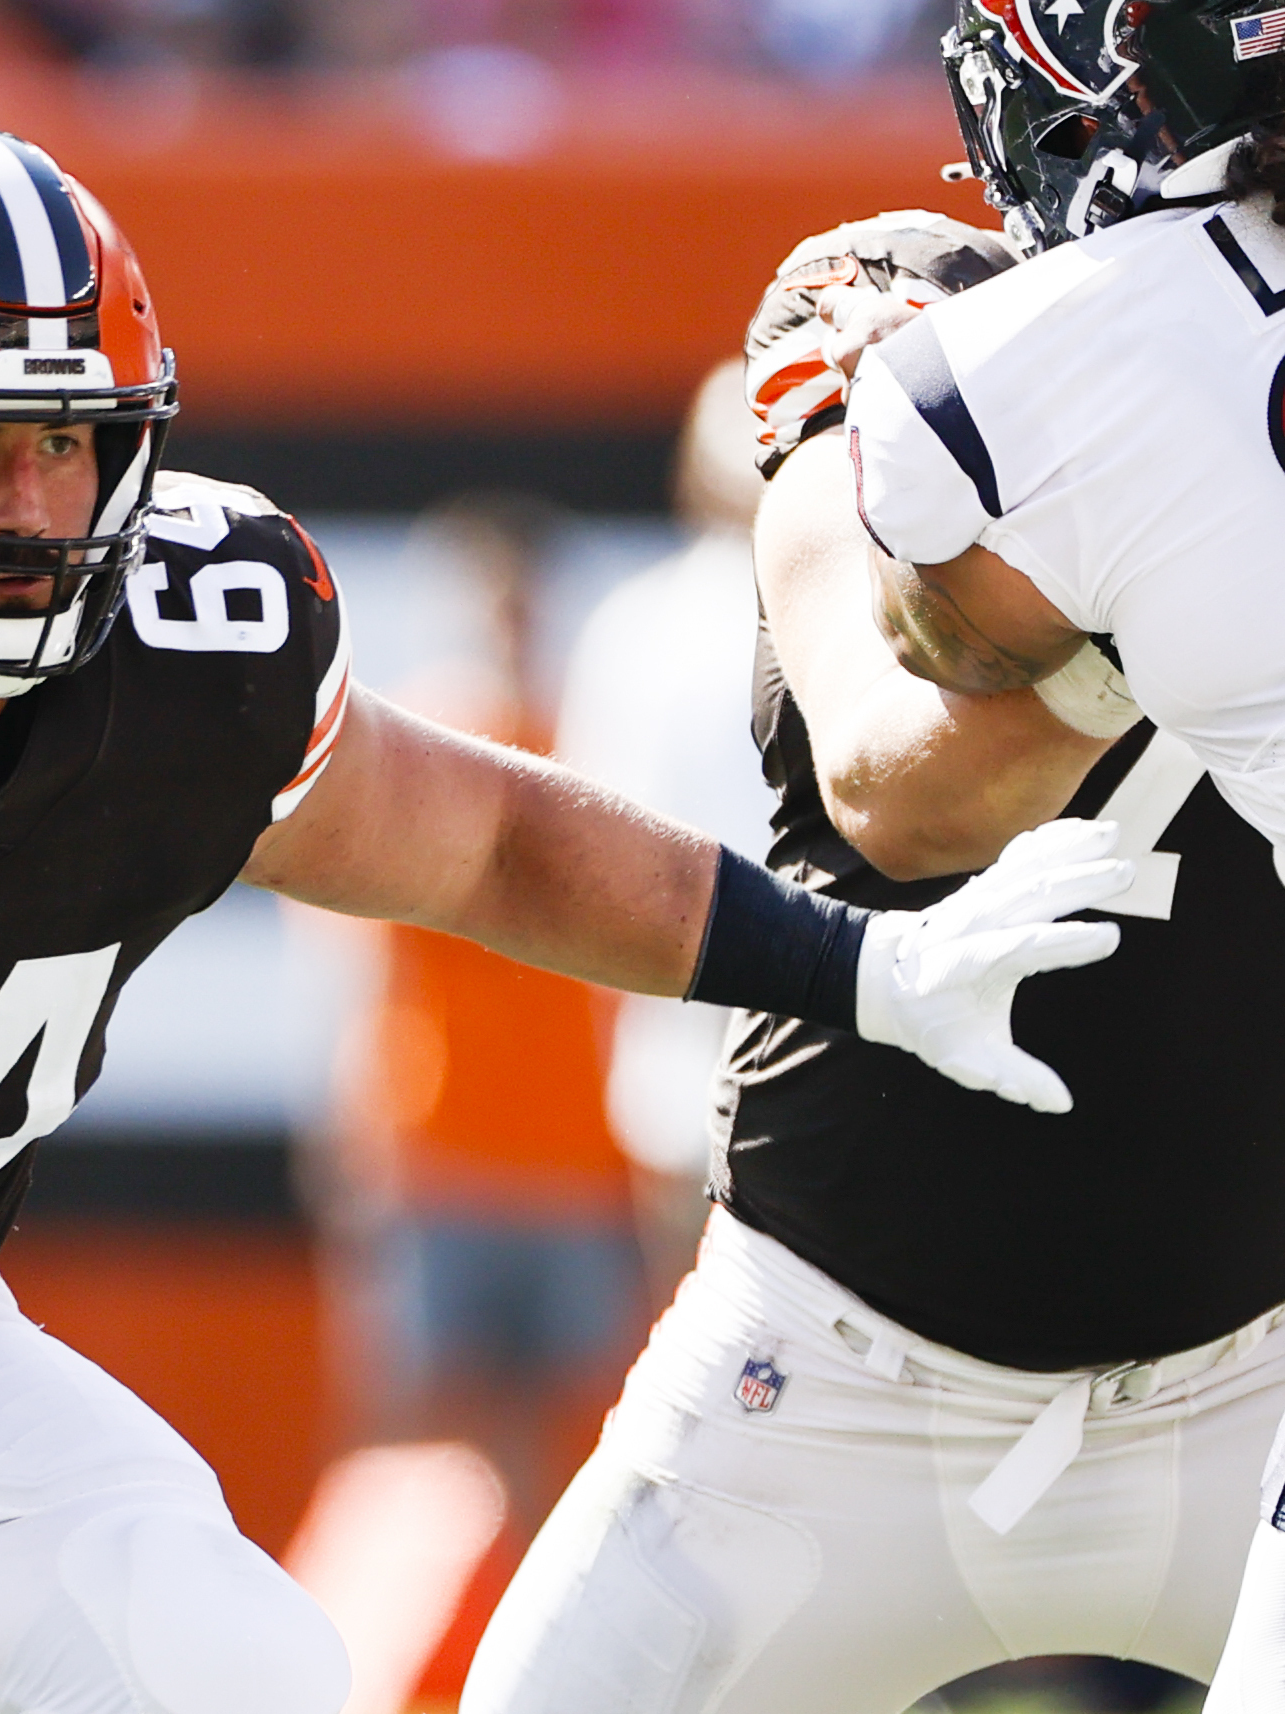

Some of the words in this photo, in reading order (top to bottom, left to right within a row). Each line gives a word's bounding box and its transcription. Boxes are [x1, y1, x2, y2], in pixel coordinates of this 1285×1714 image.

[23, 358, 86, 375] BROWNS
[125, 482, 290, 653] 64
[741, 1376, 771, 1409] NFL
